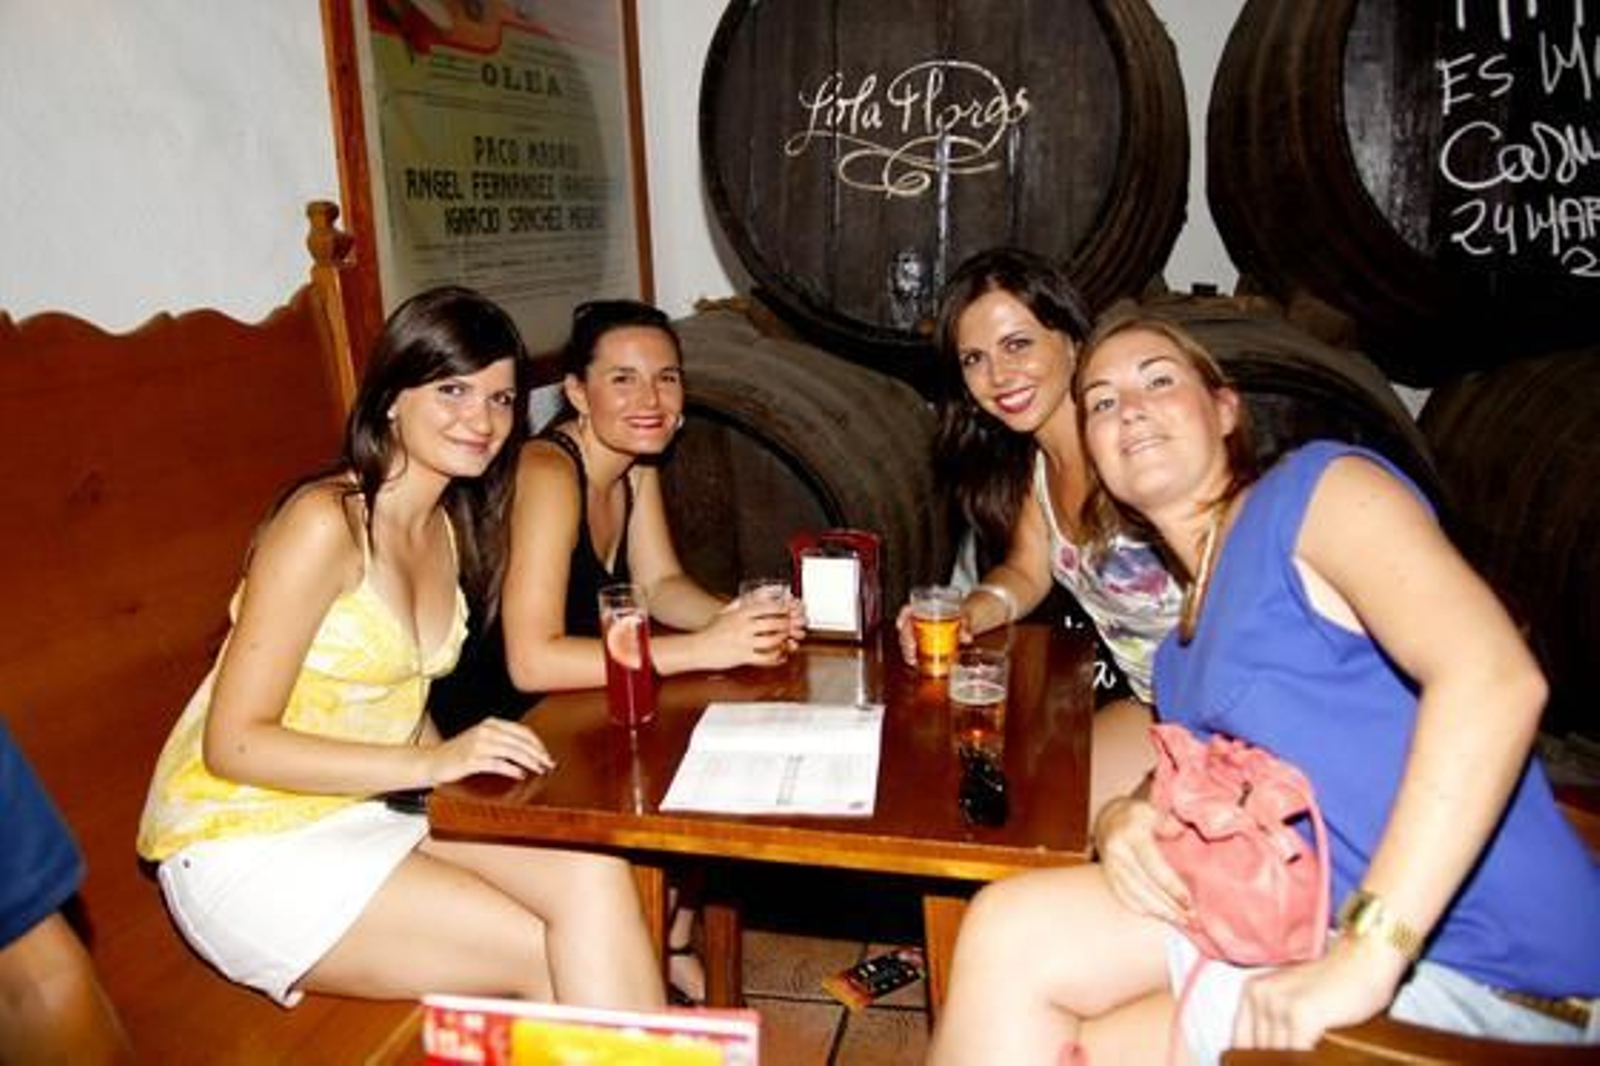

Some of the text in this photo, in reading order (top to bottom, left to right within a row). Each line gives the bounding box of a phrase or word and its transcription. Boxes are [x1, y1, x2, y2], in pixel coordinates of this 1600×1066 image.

[785, 72, 883, 154] Lola
[1434, 52, 1515, 117] ES
[405, 167, 464, 201] ANGEL
[1450, 199, 1517, 254] 24
